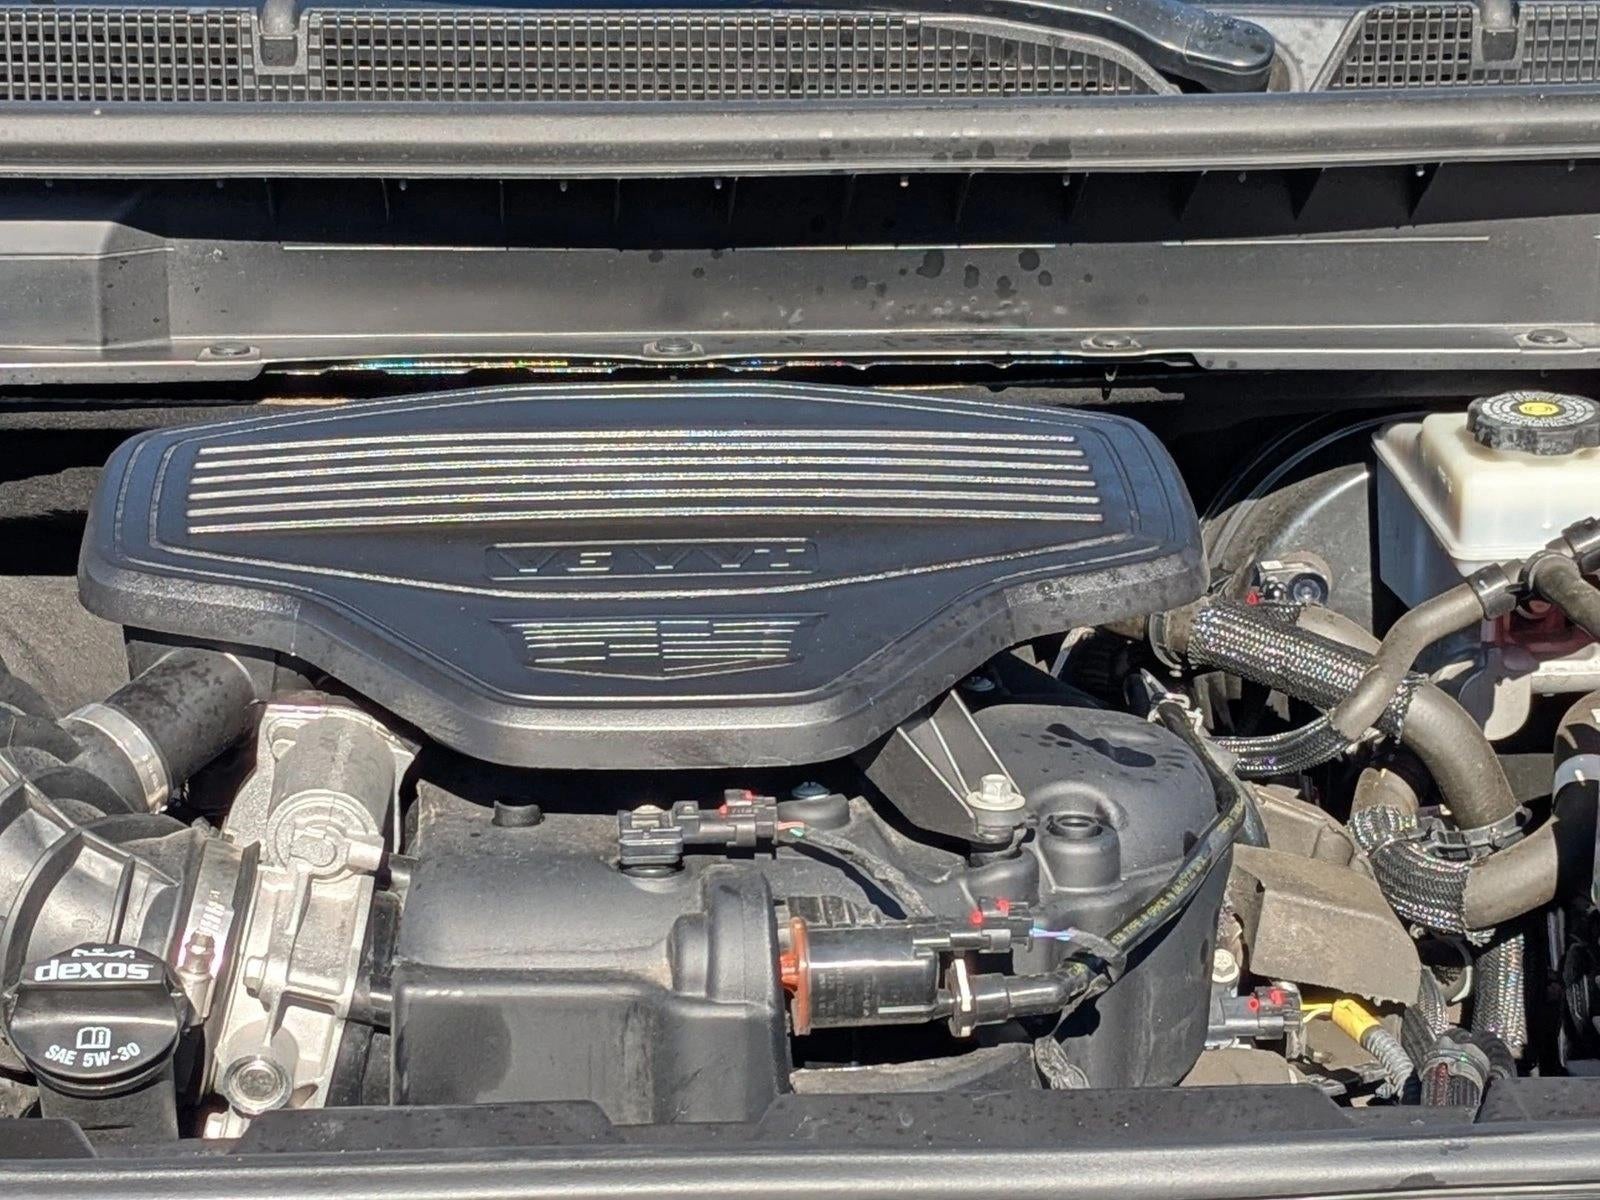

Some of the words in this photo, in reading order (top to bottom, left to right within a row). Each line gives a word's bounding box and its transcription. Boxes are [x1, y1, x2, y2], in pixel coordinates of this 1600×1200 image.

[34, 959, 154, 982] dexos
[45, 1044, 77, 1066] SAE
[82, 1042, 141, 1068] 5W-30
